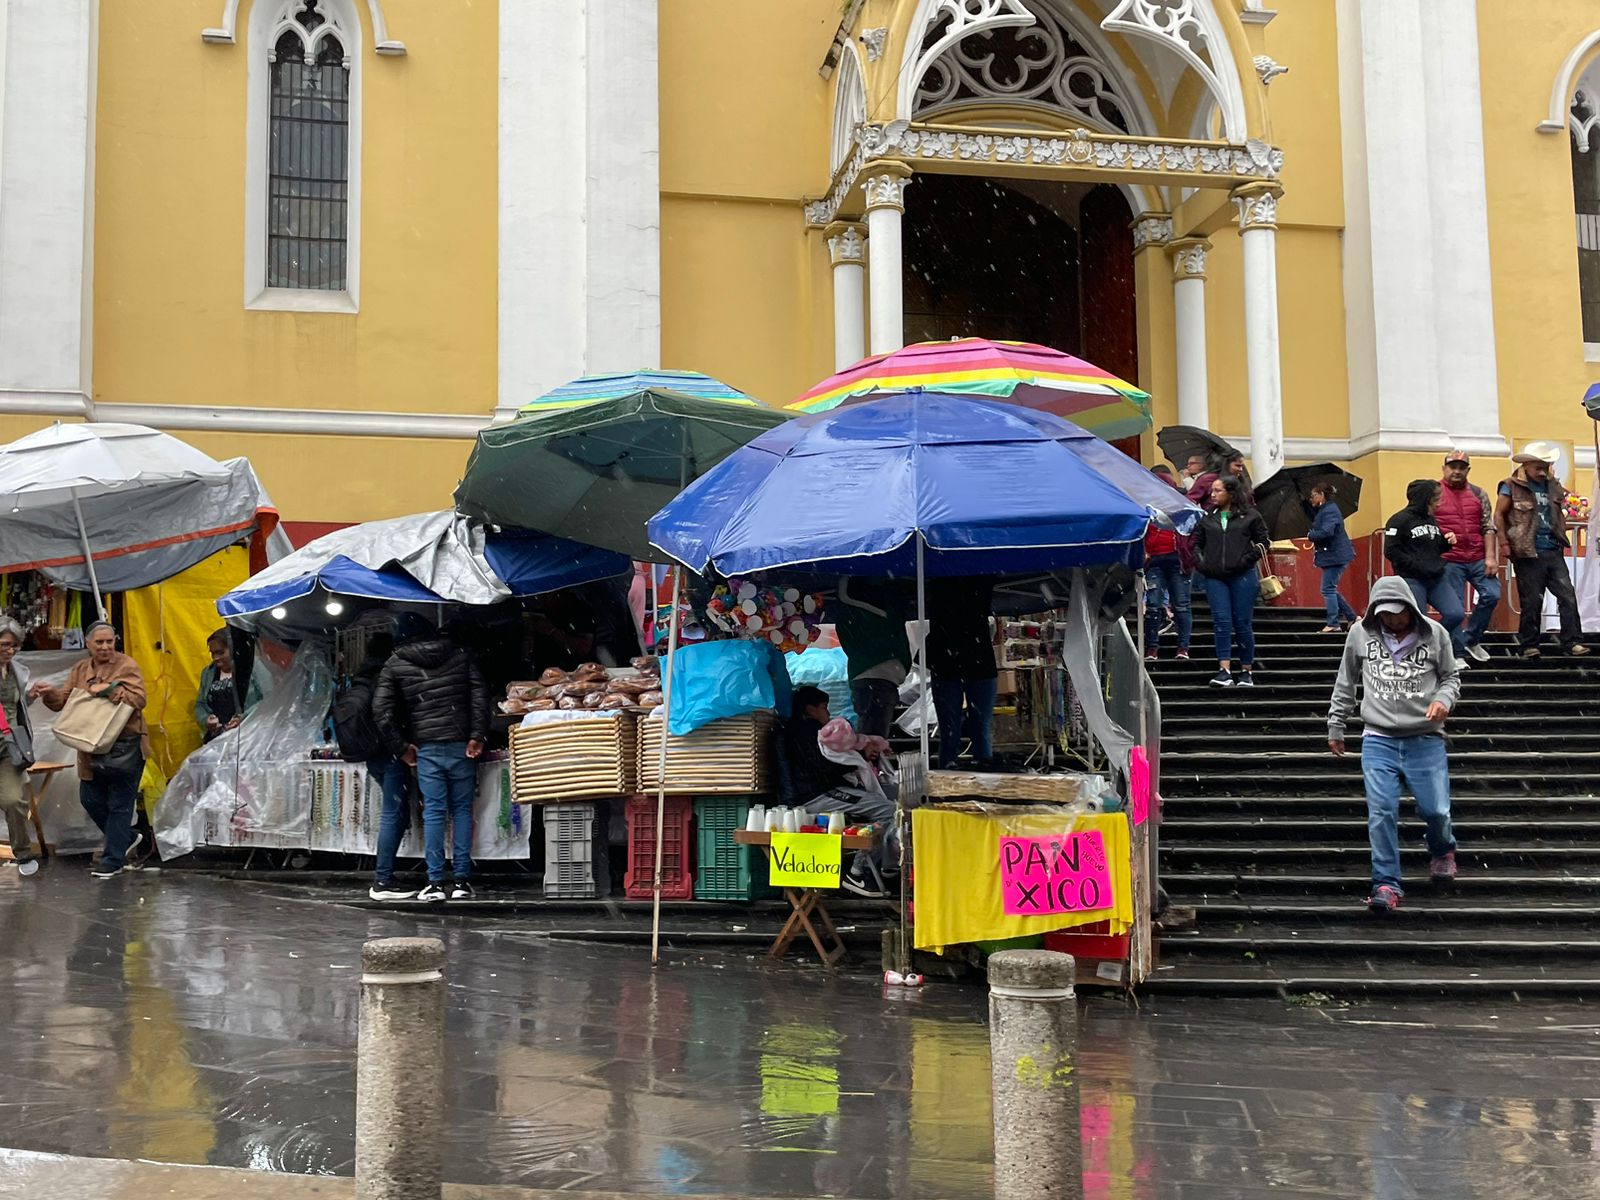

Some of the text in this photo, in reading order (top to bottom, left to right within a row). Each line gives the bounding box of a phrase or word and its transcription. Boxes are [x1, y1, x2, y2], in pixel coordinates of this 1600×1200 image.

[771, 846, 841, 875] Veladora
[1003, 837, 1080, 875] PAN
[1016, 878, 1100, 910] XICO
